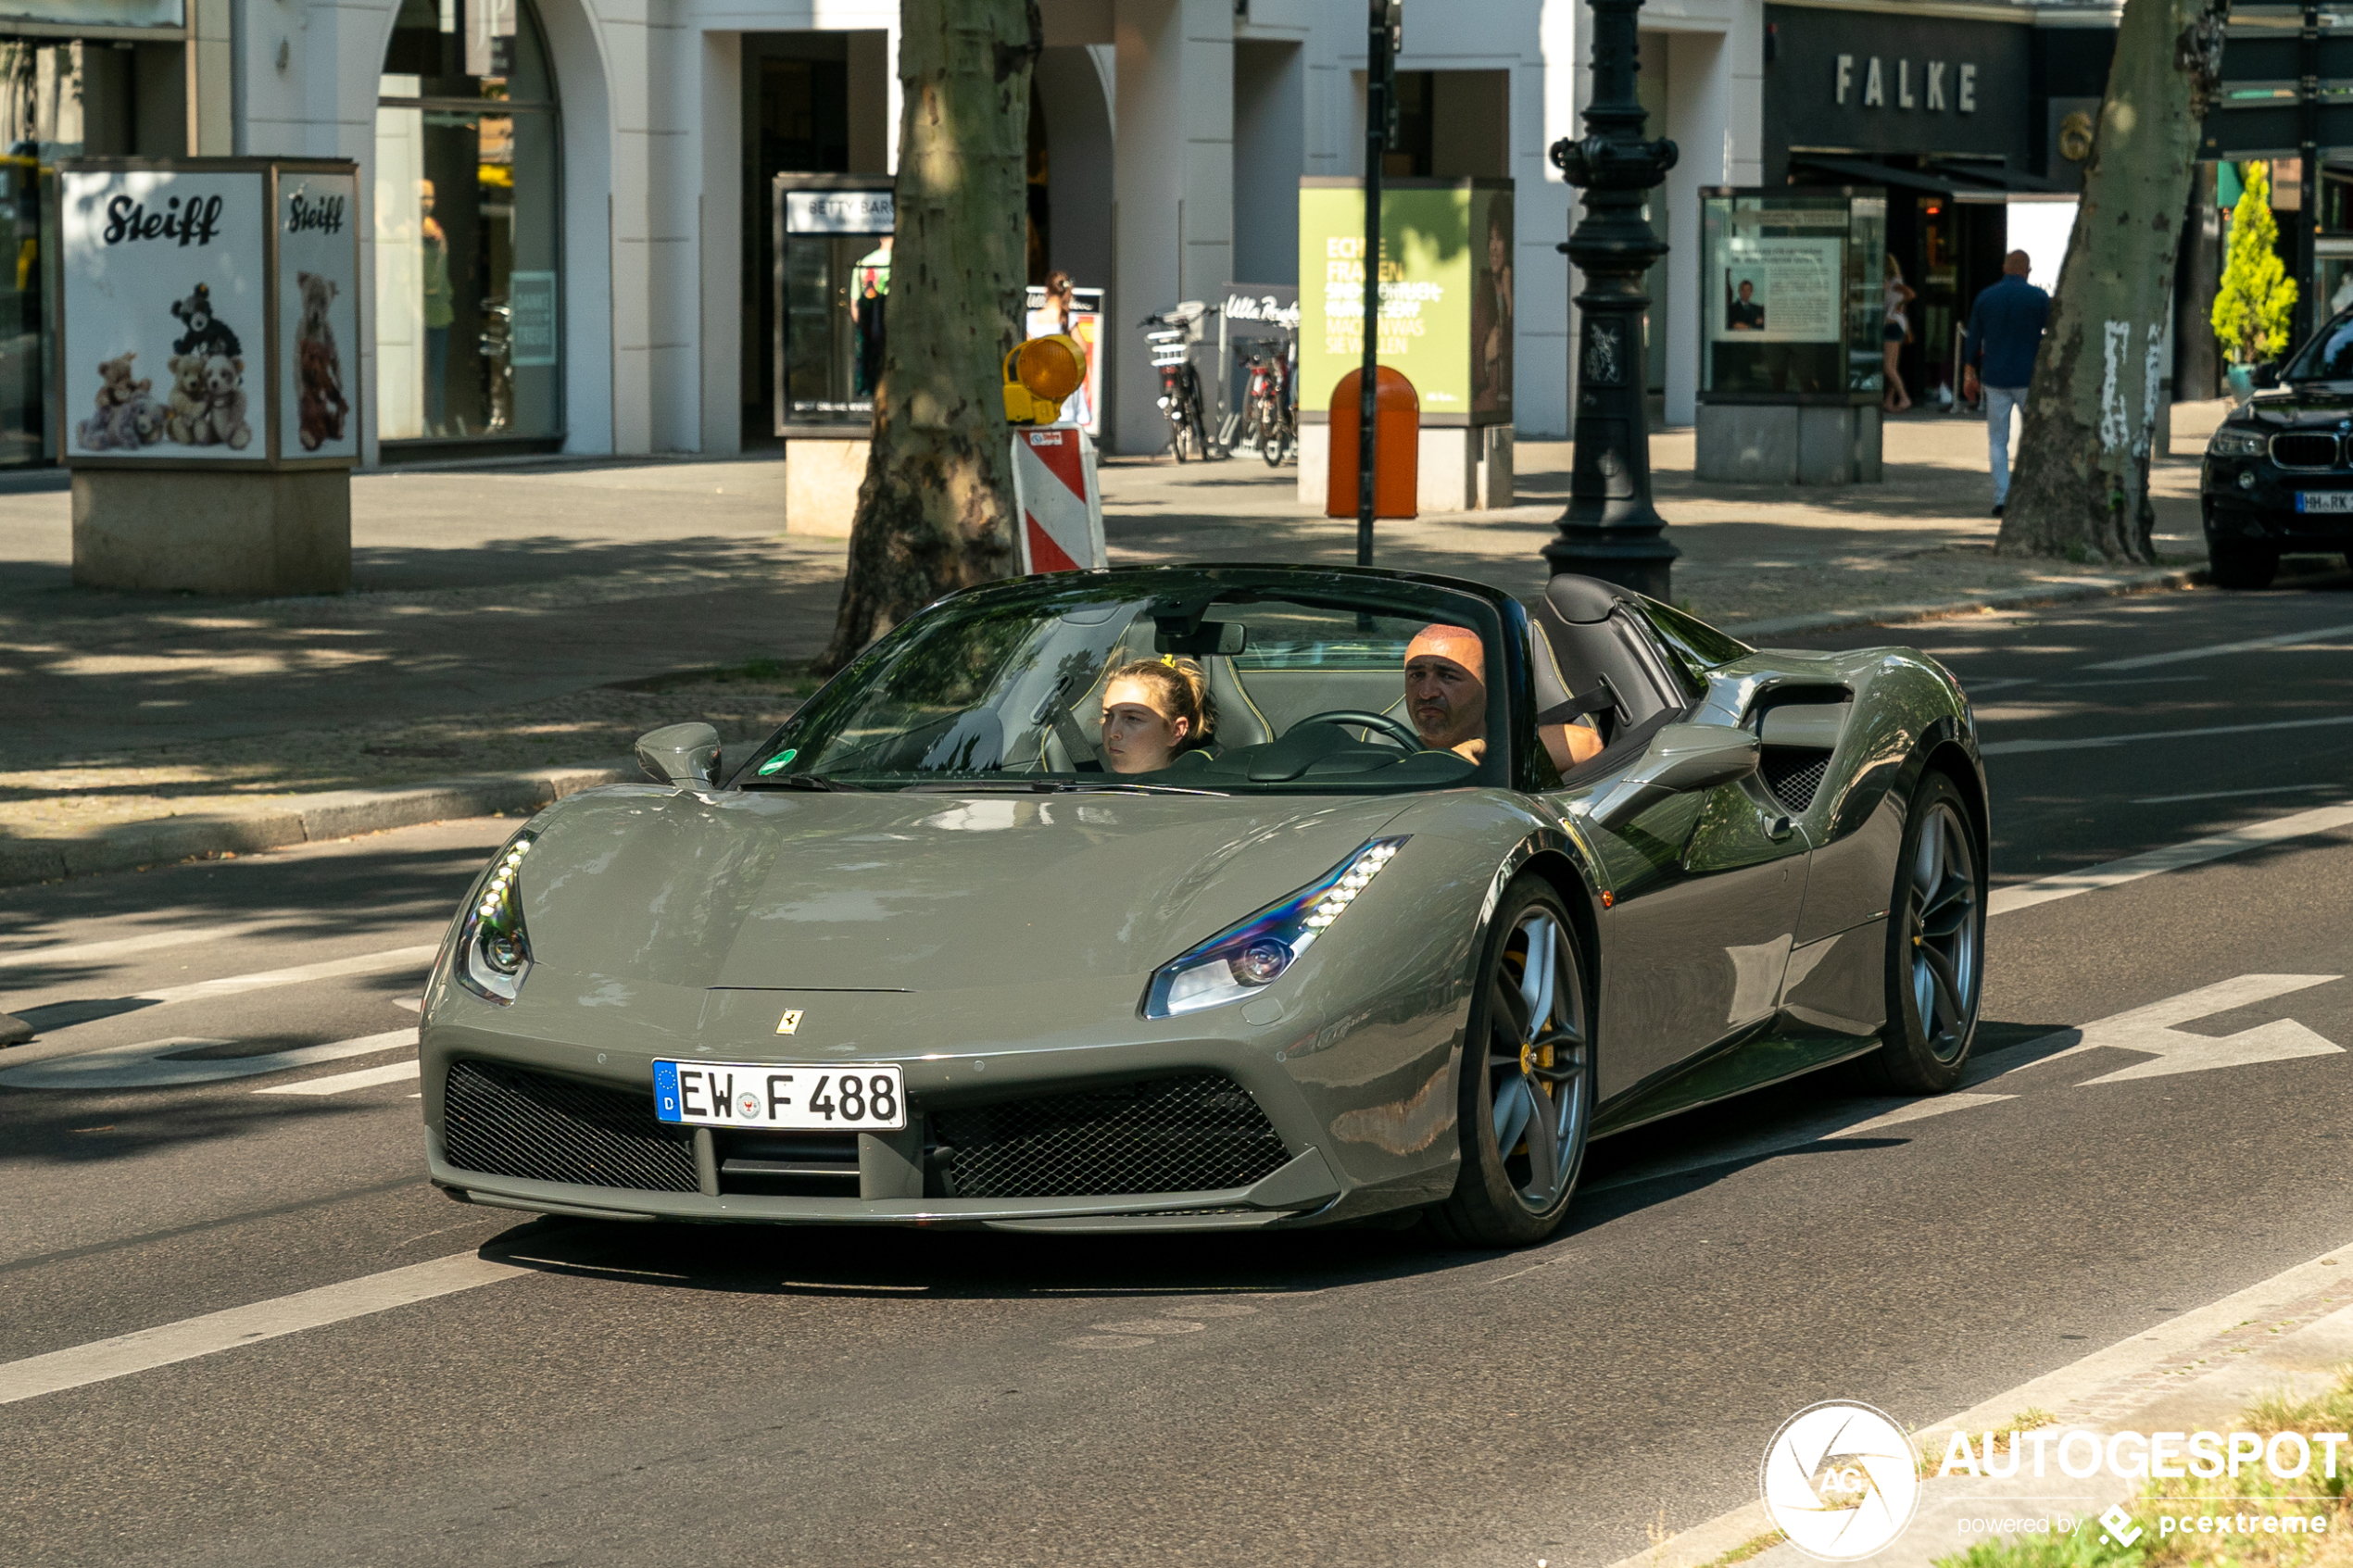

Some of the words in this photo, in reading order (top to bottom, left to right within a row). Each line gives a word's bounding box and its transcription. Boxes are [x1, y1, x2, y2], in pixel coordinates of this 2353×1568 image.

[1835, 53, 1978, 112] FALKE
[288, 195, 345, 235] Steiff
[809, 200, 853, 215] BETTY
[103, 194, 223, 247] Steiff
[1327, 260, 1403, 282] FRAEN
[1227, 294, 1260, 319] Ulla
[1390, 318, 1426, 336] WAS
[1326, 335, 1344, 354] SIE
[663, 1097, 674, 1110] D
[679, 1071, 733, 1118] EW
[766, 1074, 794, 1121] F
[809, 1074, 898, 1122] 488
